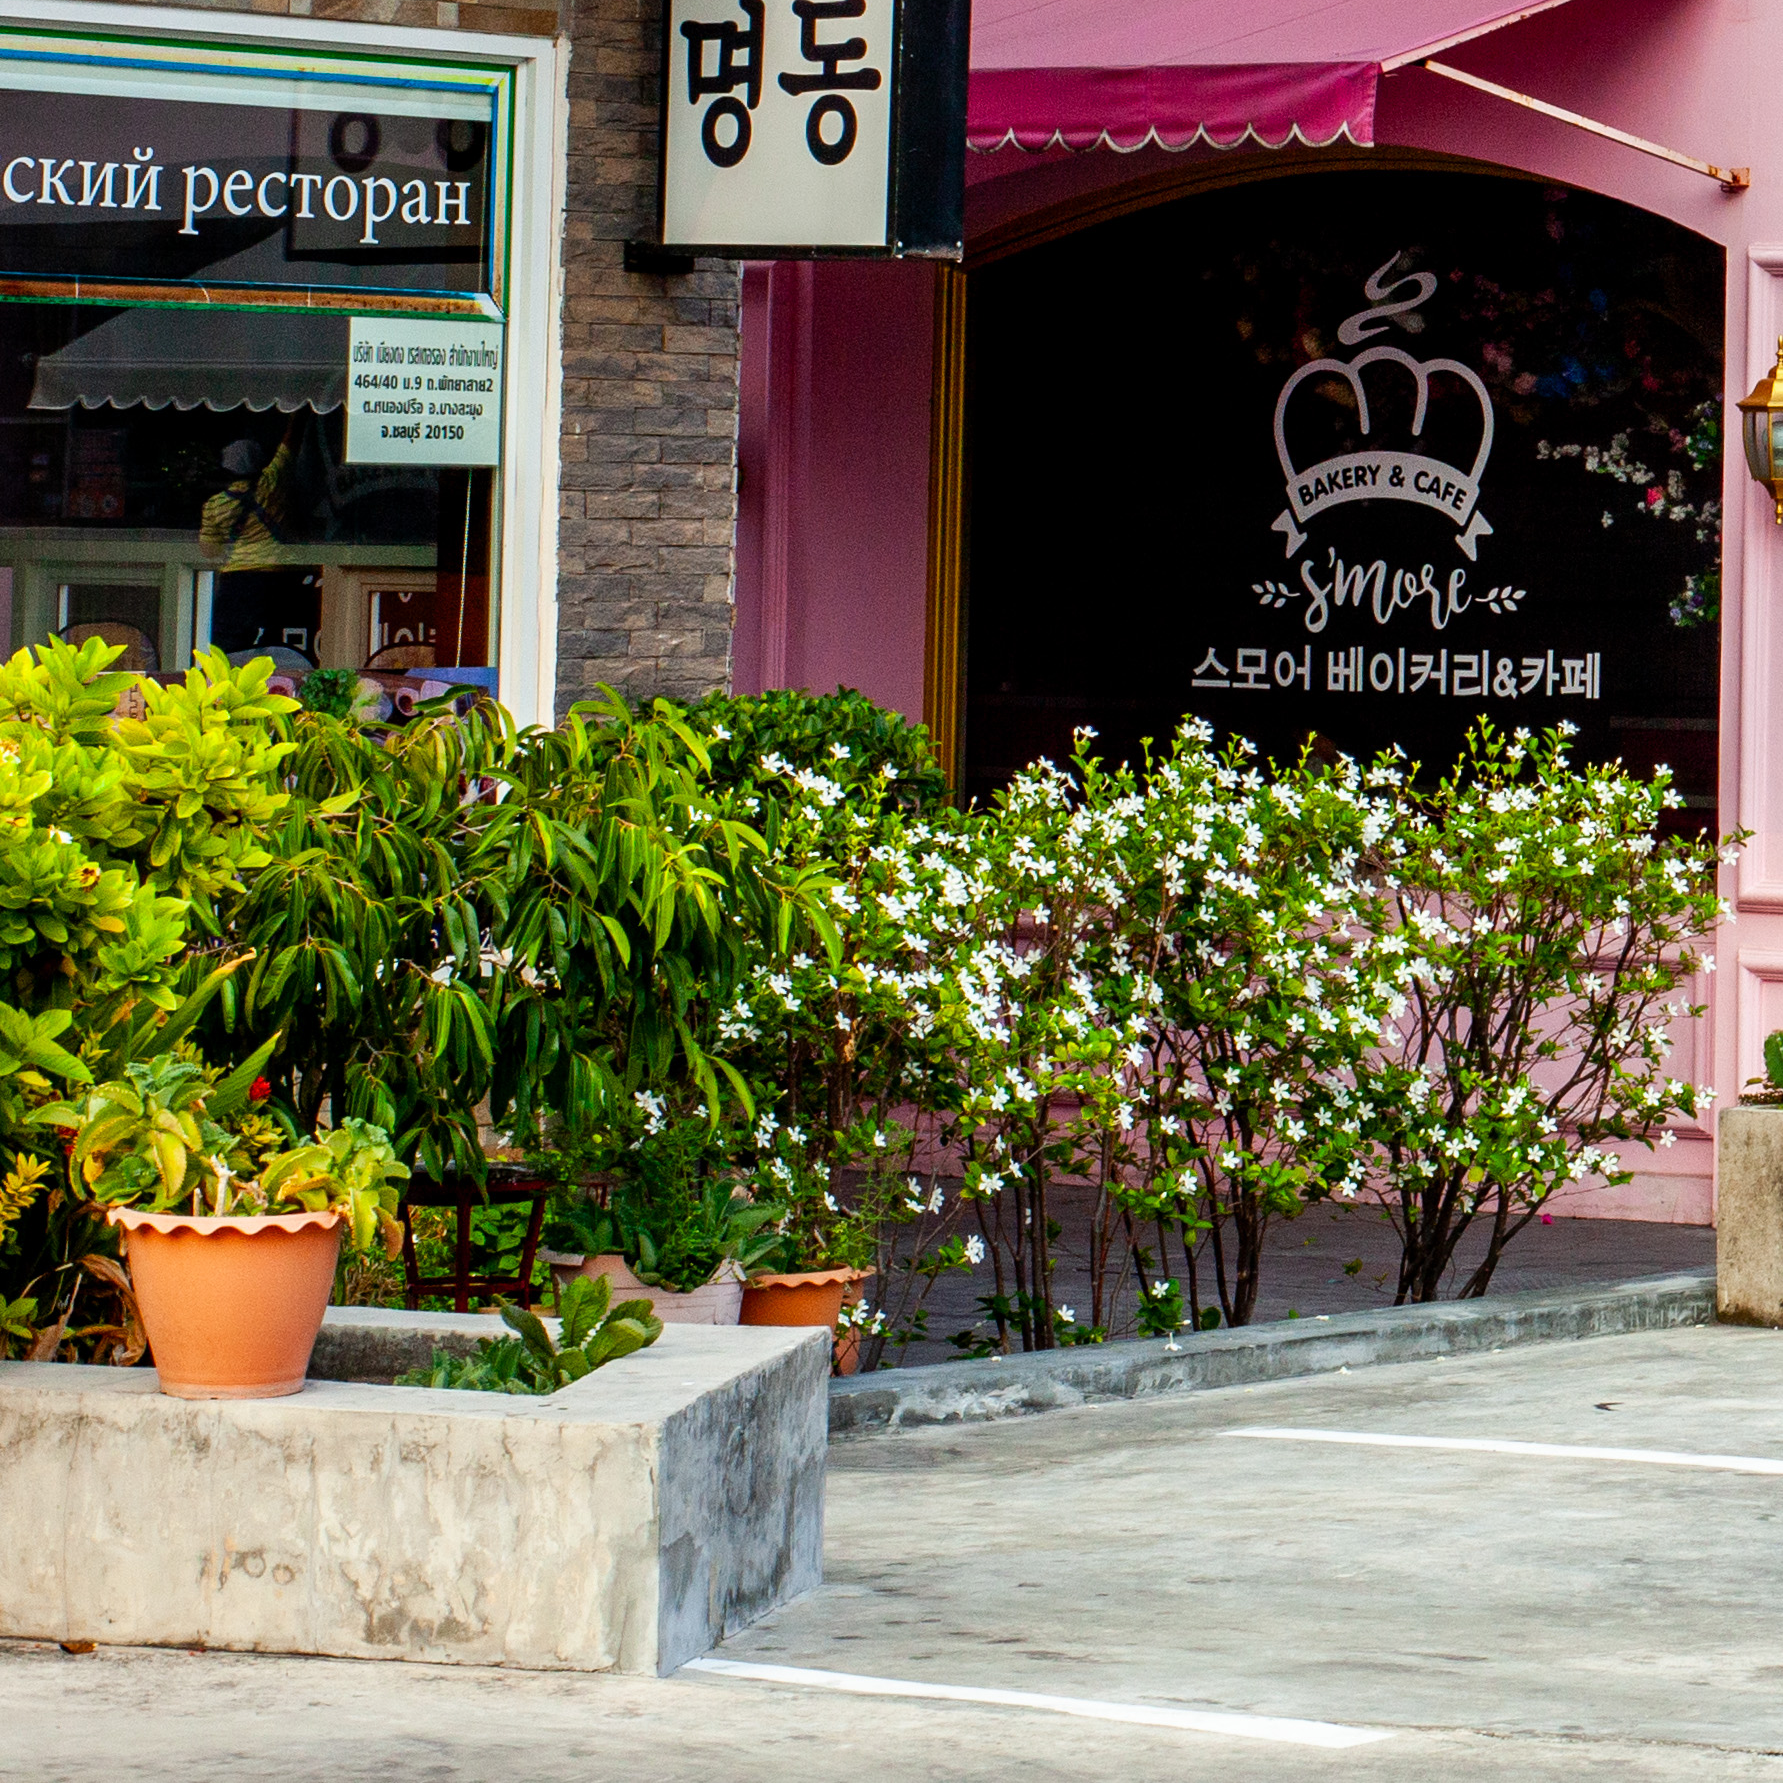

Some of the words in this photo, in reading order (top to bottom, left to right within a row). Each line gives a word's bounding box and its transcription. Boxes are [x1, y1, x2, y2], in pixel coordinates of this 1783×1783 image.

[3, 146, 164, 212] ский
[177, 166, 472, 245] ресторан
[354, 374, 398, 390] 464/40
[381, 422, 421, 443] จ.ชลบุรี
[425, 425, 464, 440] 20150
[1298, 464, 1382, 507] BAKERY
[1388, 464, 1406, 488] &
[1413, 471, 1469, 511] CAFE
[1191, 645, 1313, 691] 스모어
[1326, 645, 1602, 700] 베이커리&카페
